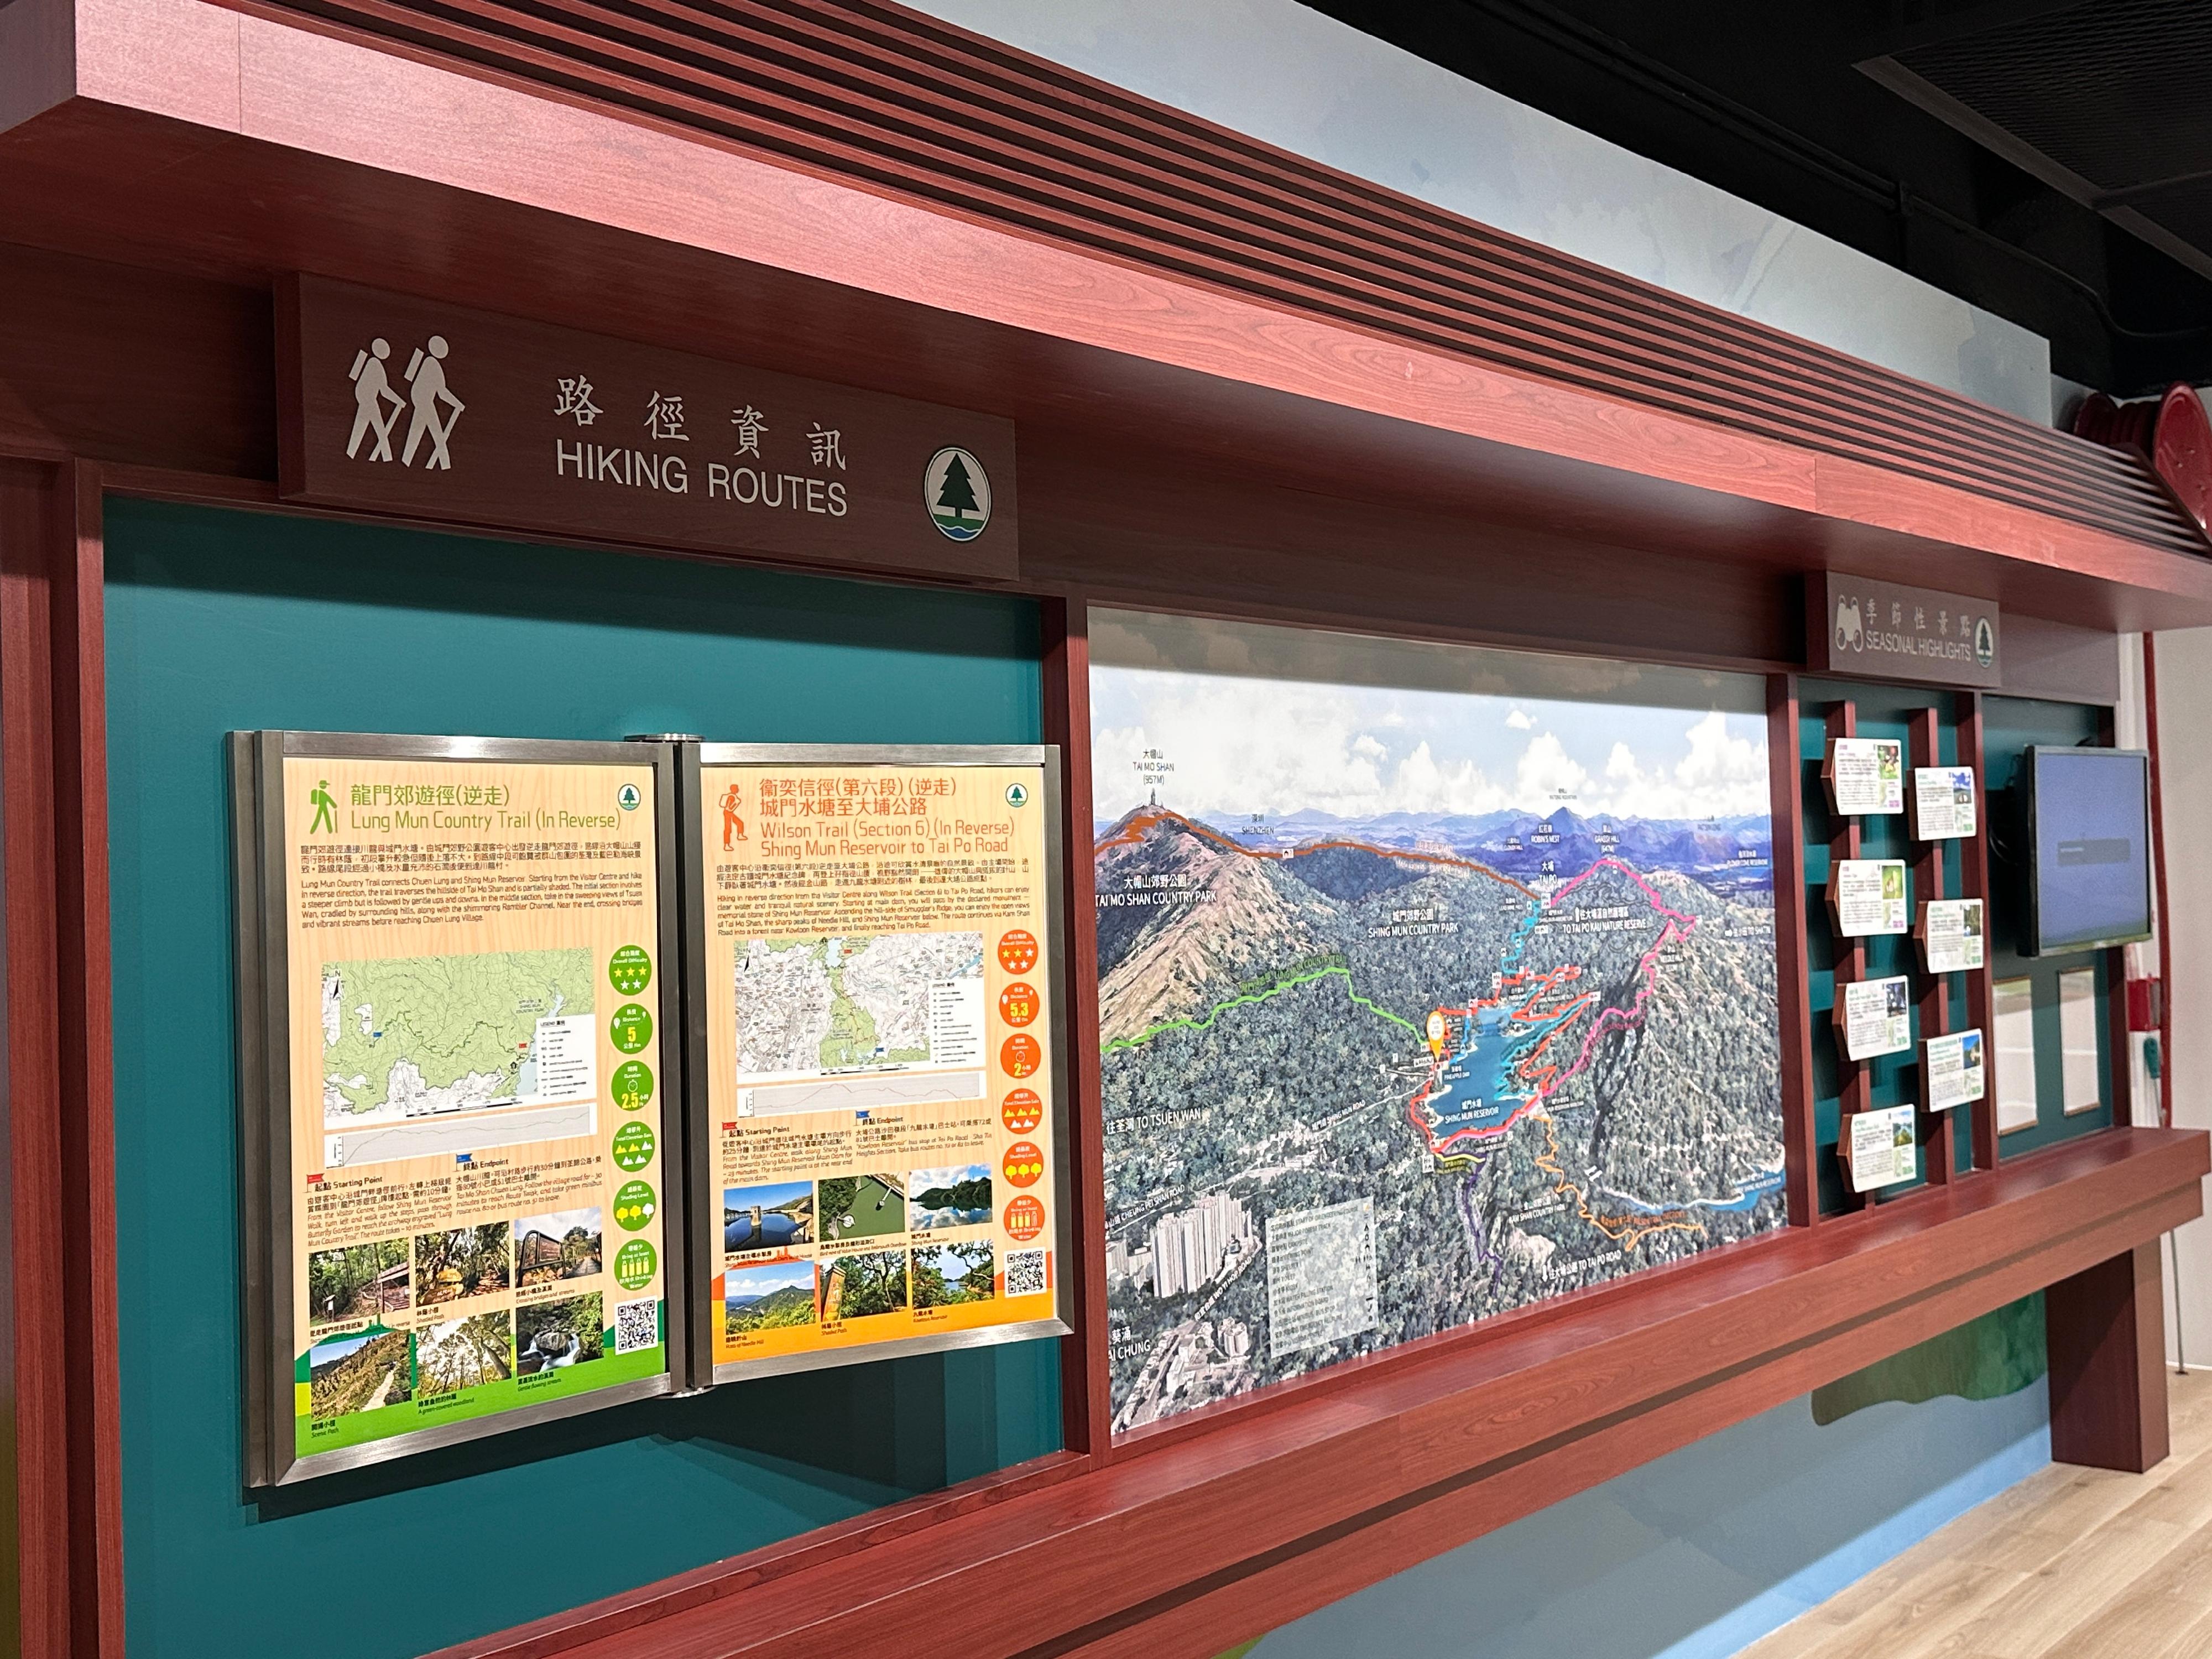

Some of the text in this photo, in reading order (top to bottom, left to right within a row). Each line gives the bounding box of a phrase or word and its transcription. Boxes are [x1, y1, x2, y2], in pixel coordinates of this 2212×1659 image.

[554, 375, 846, 470] 路徑資訊
[557, 439, 847, 517] HIKING ROUTES
[1866, 630, 1971, 661] SEASONAL HIGHLIGHTS
[1133, 761, 1174, 771] TAI MO SHAN
[351, 784, 509, 806] 龍門郊遊徑(逆走)
[760, 798, 927, 817] 城門水塘至大埔公路
[351, 807, 621, 832] Lung Mun Country Trail (In Reverse)
[760, 816, 1014, 839] Wilson Trail (Section 6) (In Reverse)
[761, 837, 1008, 859] Shing Mun Reservoir to Tai Po Road
[301, 879, 317, 889] Lung
[320, 879, 335, 888] Mun
[337, 879, 363, 888] Country
[434, 876, 449, 885] Lung
[1124, 874, 1186, 889] 大帽山郊野公園
[308, 900, 332, 910] steeper
[1095, 890, 1217, 907] TAI MO SHAN COUNTRY PARK
[1368, 922, 1458, 938] SHING MUN COUNTRY PARK
[1563, 924, 1571, 933] TO
[1582, 923, 1590, 932] PO
[1010, 1002, 1029, 1017] 5.3
[628, 1026, 637, 1042] 5
[1014, 1062, 1021, 1077] 2
[621, 1092, 639, 1109] 2.5
[1137, 1115, 1149, 1129] TO
[1150, 1110, 1179, 1127] TSUEN
[1181, 1107, 1202, 1121] WAN
[1445, 1113, 1460, 1124] SHING
[745, 1126, 771, 1135] Starting
[480, 1159, 509, 1170] Endpoint
[333, 1178, 363, 1188] Starting
[364, 1176, 383, 1185] Point
[1121, 1204, 1145, 1220] CHEUNG
[1155, 1193, 1170, 1208] SHAN
[1170, 1184, 1185, 1201] ROAD
[1578, 1259, 1587, 1270] TO
[1588, 1256, 1597, 1267] TAI
[1597, 1254, 1606, 1265] PO
[1606, 1250, 1621, 1262] ROAD
[1227, 1272, 1238, 1285] HOP
[1238, 1256, 1252, 1274] ROAD
[1112, 1326, 1131, 1344] 葵涌
[1118, 1339, 1151, 1360] CHUNG
